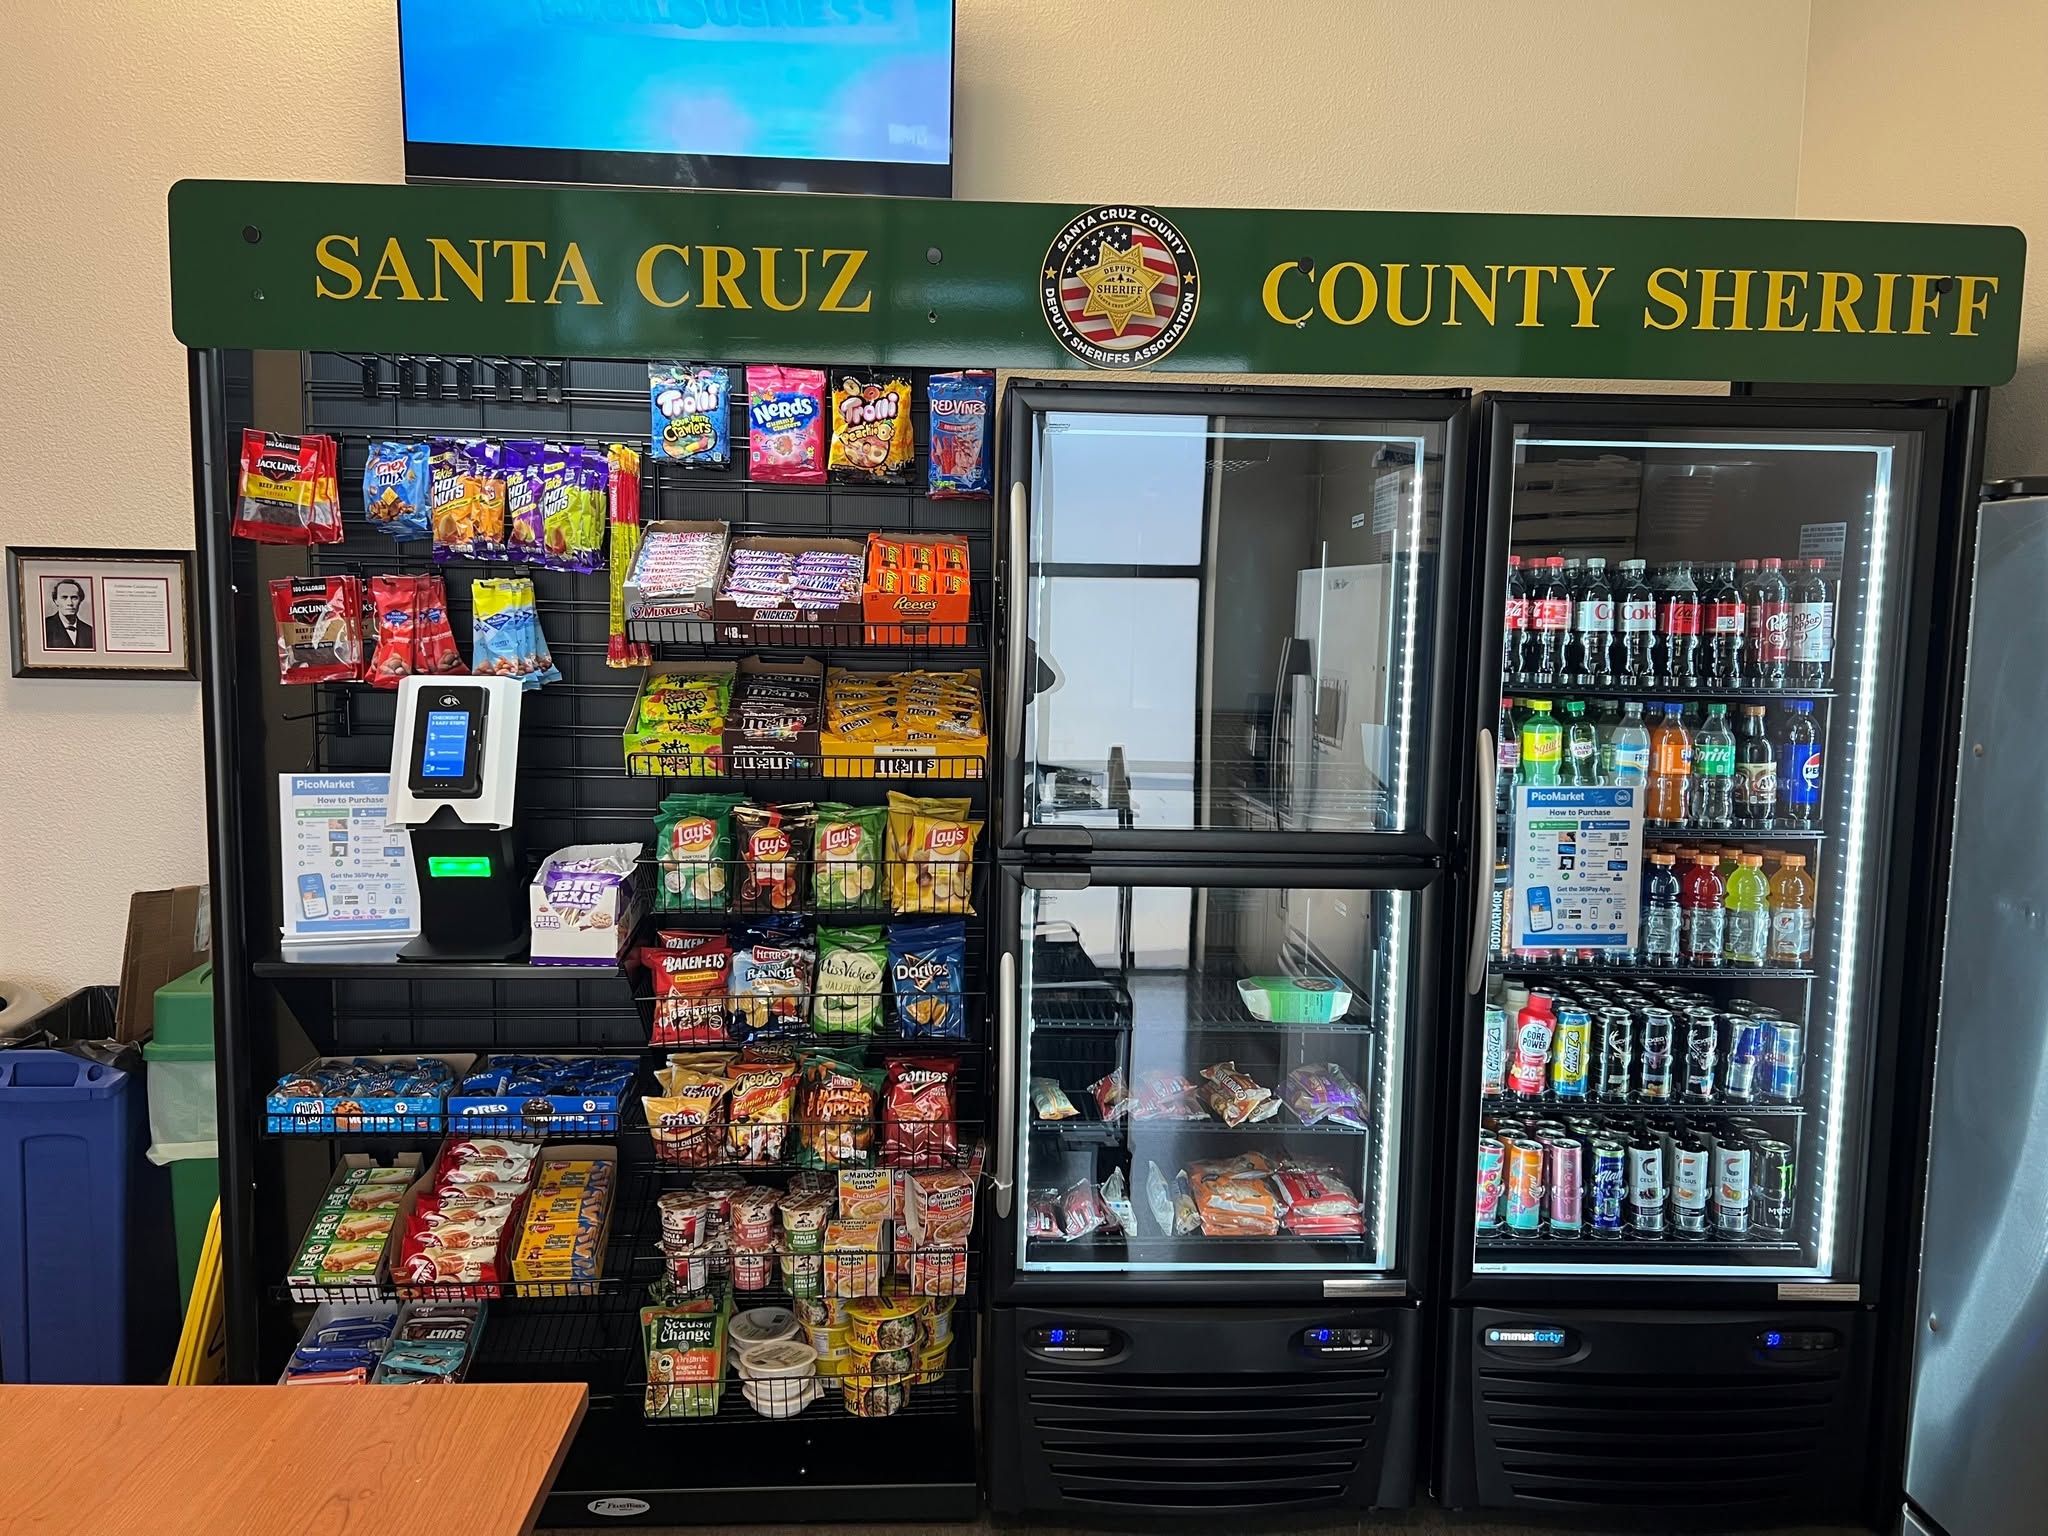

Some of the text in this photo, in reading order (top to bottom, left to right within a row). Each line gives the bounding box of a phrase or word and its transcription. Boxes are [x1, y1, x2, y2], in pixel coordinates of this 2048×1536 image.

[1057, 208, 1186, 255] SANTA CRUZ COUNTY
[314, 232, 873, 314] SANTA CRUZ
[1103, 265, 1138, 275] DEPUTY
[1096, 285, 1143, 295] SHERIFF
[1261, 260, 2000, 337] COUNTY SHERIFF
[1045, 287, 1195, 364] DEPUTY SHERIFFS ASSOCIATION
[656, 382, 719, 418] Trolli
[840, 391, 899, 425] Trolli
[663, 423, 712, 441] Crawlers
[256, 458, 302, 473] JACK LINK'S
[432, 466, 453, 480] Takis
[258, 481, 293, 492] BEEF JERKY
[434, 476, 459, 495] HOT
[508, 481, 529, 499] HOT
[545, 483, 568, 501] HOT
[434, 484, 464, 508] NUTS
[544, 495, 569, 518] NUTS
[800, 580, 839, 591] ALFTIME
[893, 595, 938, 610] Reese's
[289, 605, 308, 615] JACK
[632, 606, 642, 618] 3
[755, 609, 797, 620] SNICKERS
[1621, 604, 1656, 620] Coke
[668, 700, 706, 713] SOUR
[1693, 746, 1731, 765] Sprite
[296, 779, 355, 789] PicoMarket
[348, 796, 384, 804] Purchase
[1531, 791, 1585, 801] PicoMarket
[1578, 808, 1611, 817] Purchase
[677, 822, 713, 846] Lay's
[826, 826, 858, 849] Lay's
[930, 827, 965, 848] Lay's
[754, 836, 789, 856] Lay's
[375, 871, 389, 880] App
[552, 878, 602, 893] BIG
[1578, 886, 1599, 894] 365Pay
[1599, 886, 1611, 894] App
[548, 890, 601, 904] TEXAS
[534, 921, 561, 929] TEXAS
[535, 915, 557, 923] BIG
[1490, 890, 1503, 951] BODYARMOR
[662, 953, 725, 973] BAKEN-ETS
[746, 966, 796, 981] RANCH
[842, 959, 879, 983] Vickie's
[896, 961, 950, 980] Doritos
[1526, 1030, 1545, 1041] CORE
[1522, 1037, 1547, 1049] POWER
[1522, 1066, 1537, 1079] 26
[732, 1070, 783, 1097] Cheetos
[764, 1089, 779, 1102] Hot
[294, 1101, 319, 1114] Chips
[463, 1104, 508, 1119] OREO
[584, 1102, 594, 1110] 12
[816, 1100, 870, 1116] POPPERS
[660, 1111, 702, 1132] Fritos
[849, 1171, 887, 1179] Maruchan
[327, 1193, 350, 1201] APPLE
[935, 1187, 972, 1201] Maruchan
[940, 1202, 961, 1211] Lunch
[315, 1222, 338, 1230] APPLE
[317, 1228, 330, 1236] PIE
[300, 1253, 325, 1261] APPLE
[303, 1259, 316, 1267] PIE
[664, 1318, 703, 1330] Seeds
[427, 1329, 466, 1339] BUILT
[660, 1328, 711, 1343] Change
[855, 1331, 871, 1346] PHO
